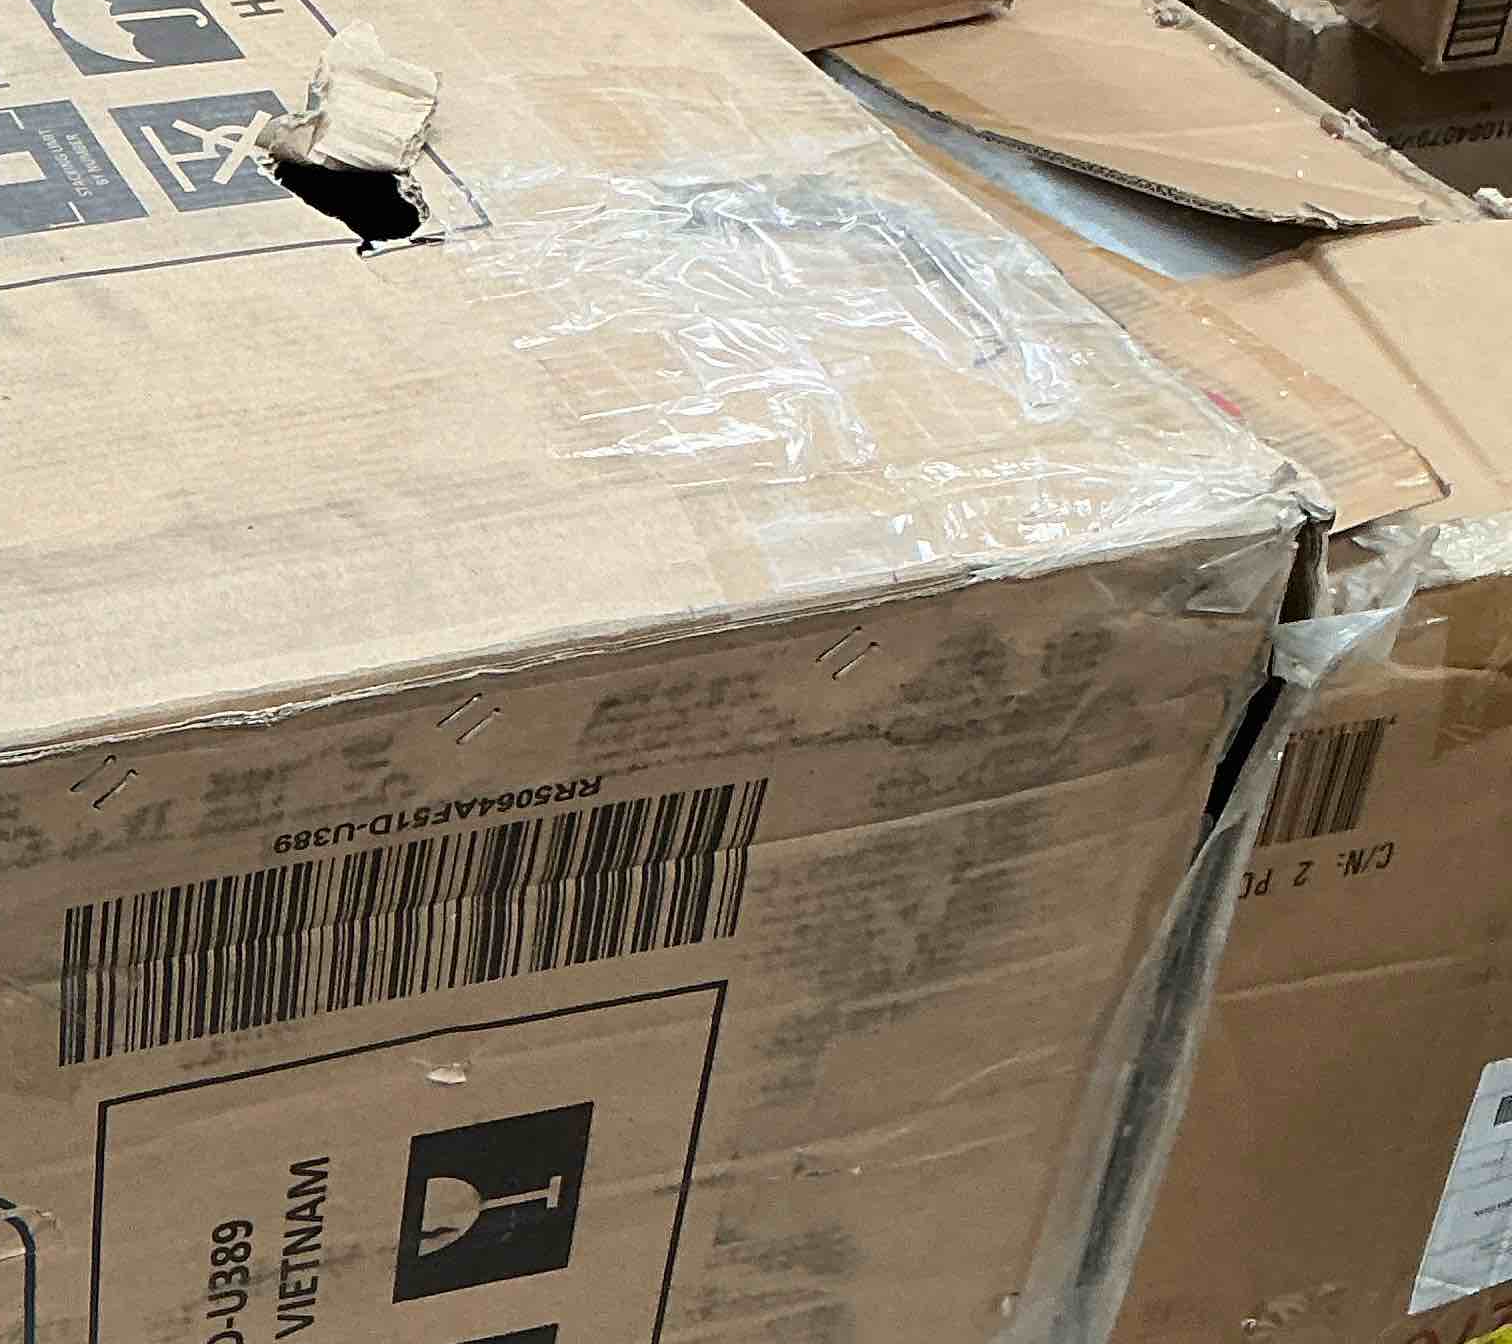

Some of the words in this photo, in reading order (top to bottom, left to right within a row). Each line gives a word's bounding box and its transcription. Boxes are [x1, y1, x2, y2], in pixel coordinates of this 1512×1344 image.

[271, 772, 604, 855] RR5064AF51D-U389
[1293, 861, 1315, 887] 2
[274, 1155, 331, 1341] VIETNAM
